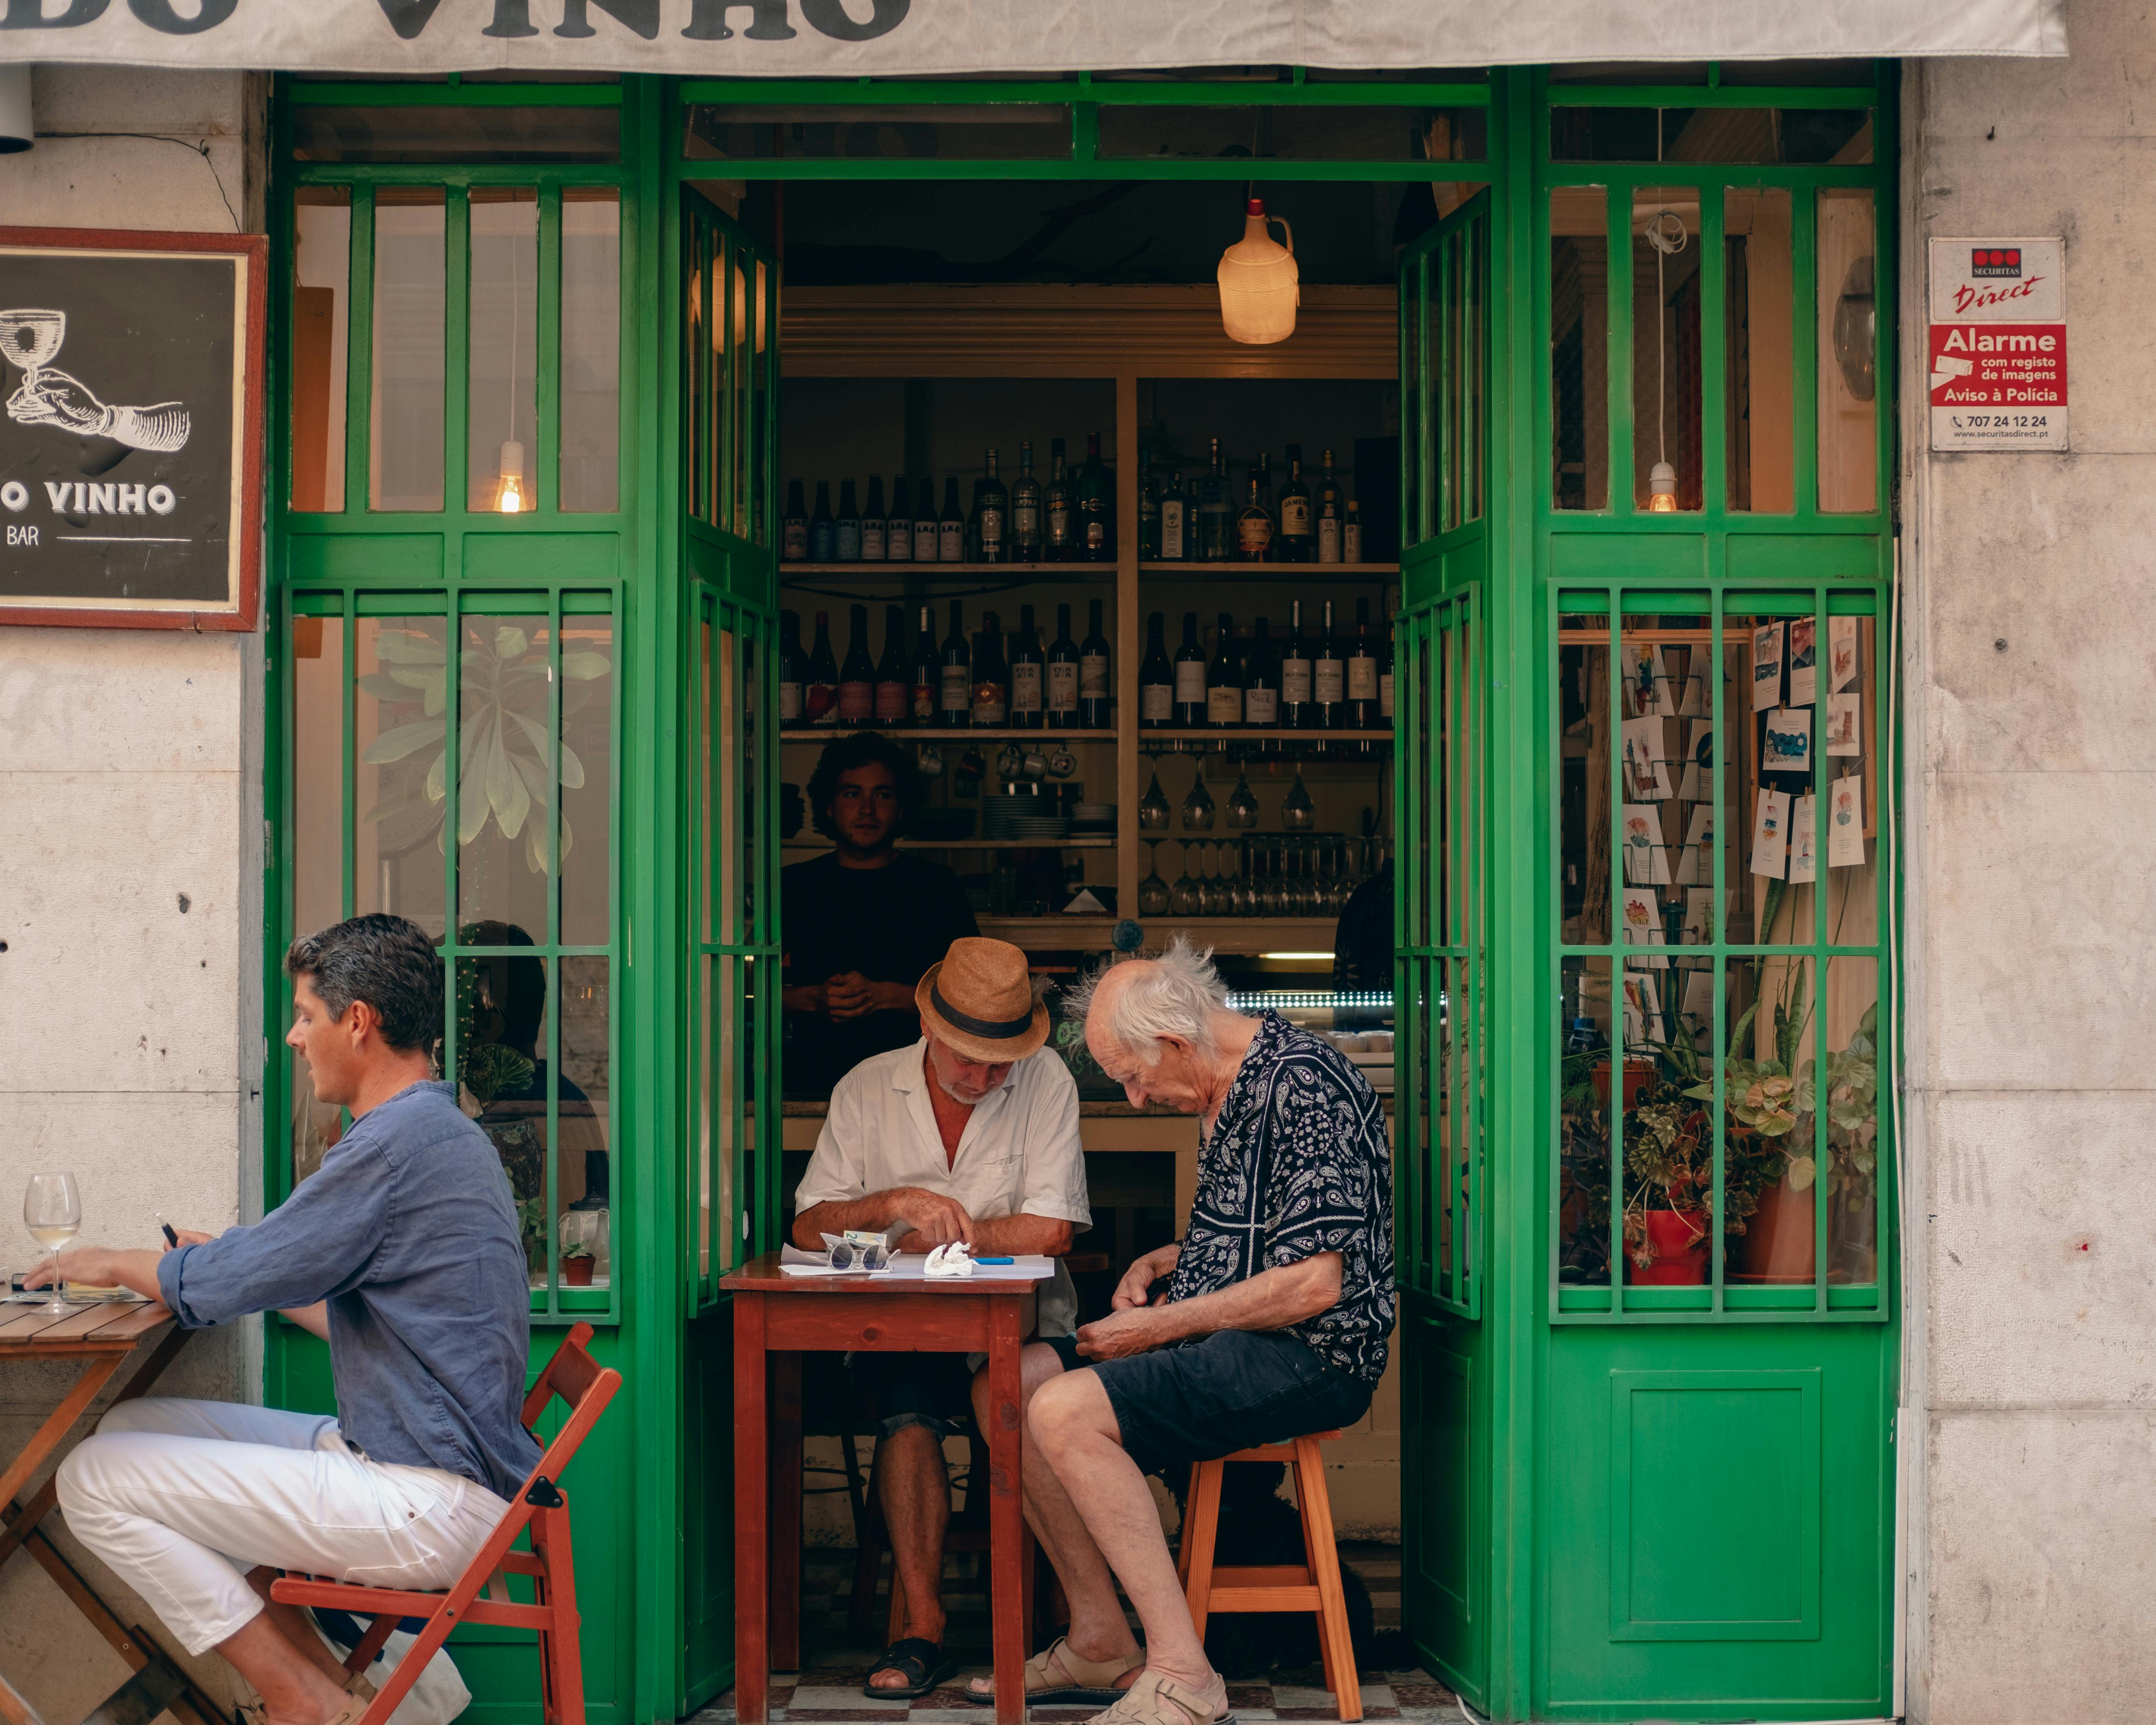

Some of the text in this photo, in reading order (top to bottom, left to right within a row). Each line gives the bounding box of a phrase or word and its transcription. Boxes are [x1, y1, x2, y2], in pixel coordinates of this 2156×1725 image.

[1953, 276, 2047, 314] Direct
[1943, 327, 2056, 351] Alarme
[1981, 356, 2056, 370] com registo
[1981, 368, 2056, 383] de imagens
[1944, 387, 2058, 402] Aviso à Polícia
[1967, 416, 2047, 427] 707 24 12 24
[1954, 429, 2048, 439] www.securitasdirect.pt
[43, 482, 176, 515] VINHO
[7, 525, 39, 546] BAR
